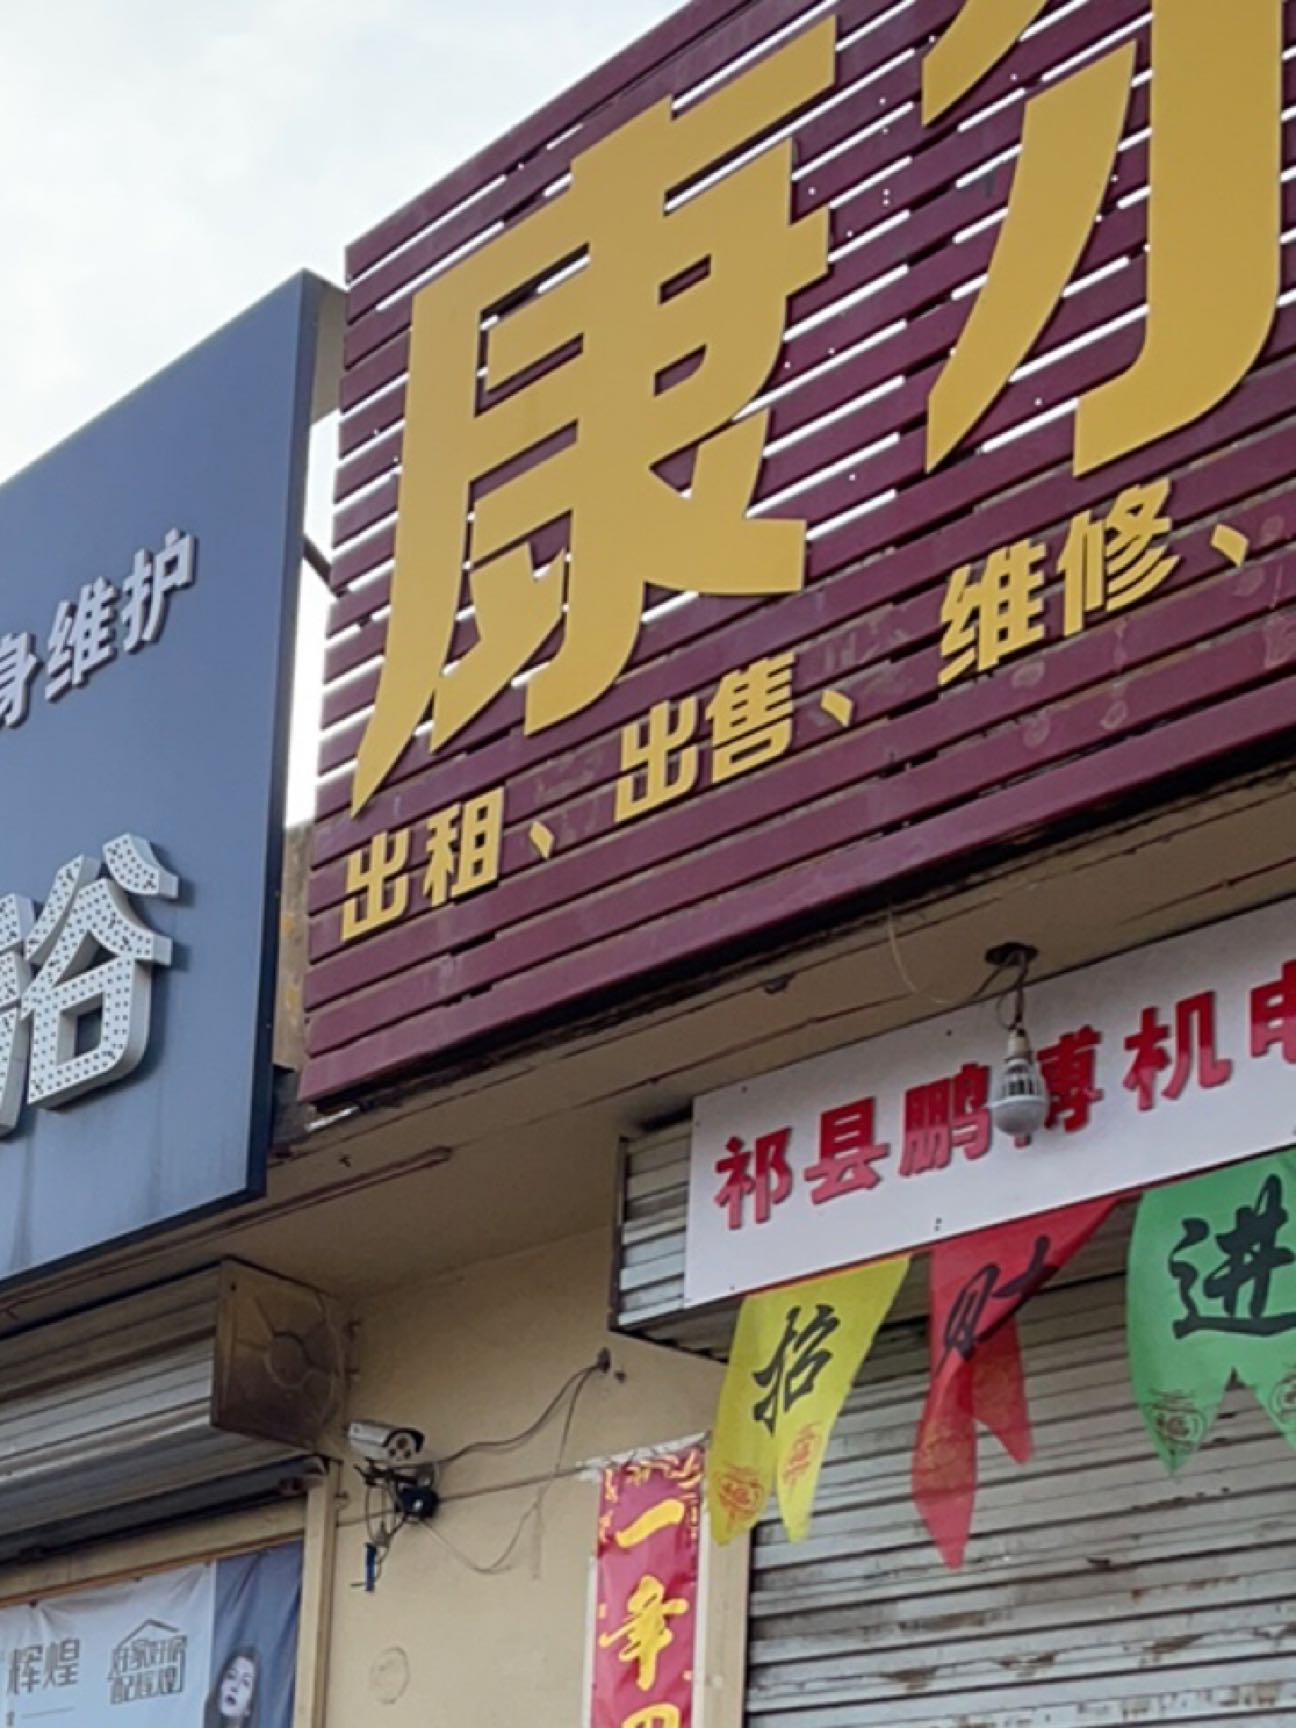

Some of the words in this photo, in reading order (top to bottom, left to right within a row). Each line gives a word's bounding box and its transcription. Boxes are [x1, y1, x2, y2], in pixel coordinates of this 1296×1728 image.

[752, 1304, 840, 1438] 招
[1167, 1173, 1296, 1341] 进
[8, 1638, 81, 1695] 辉煌
